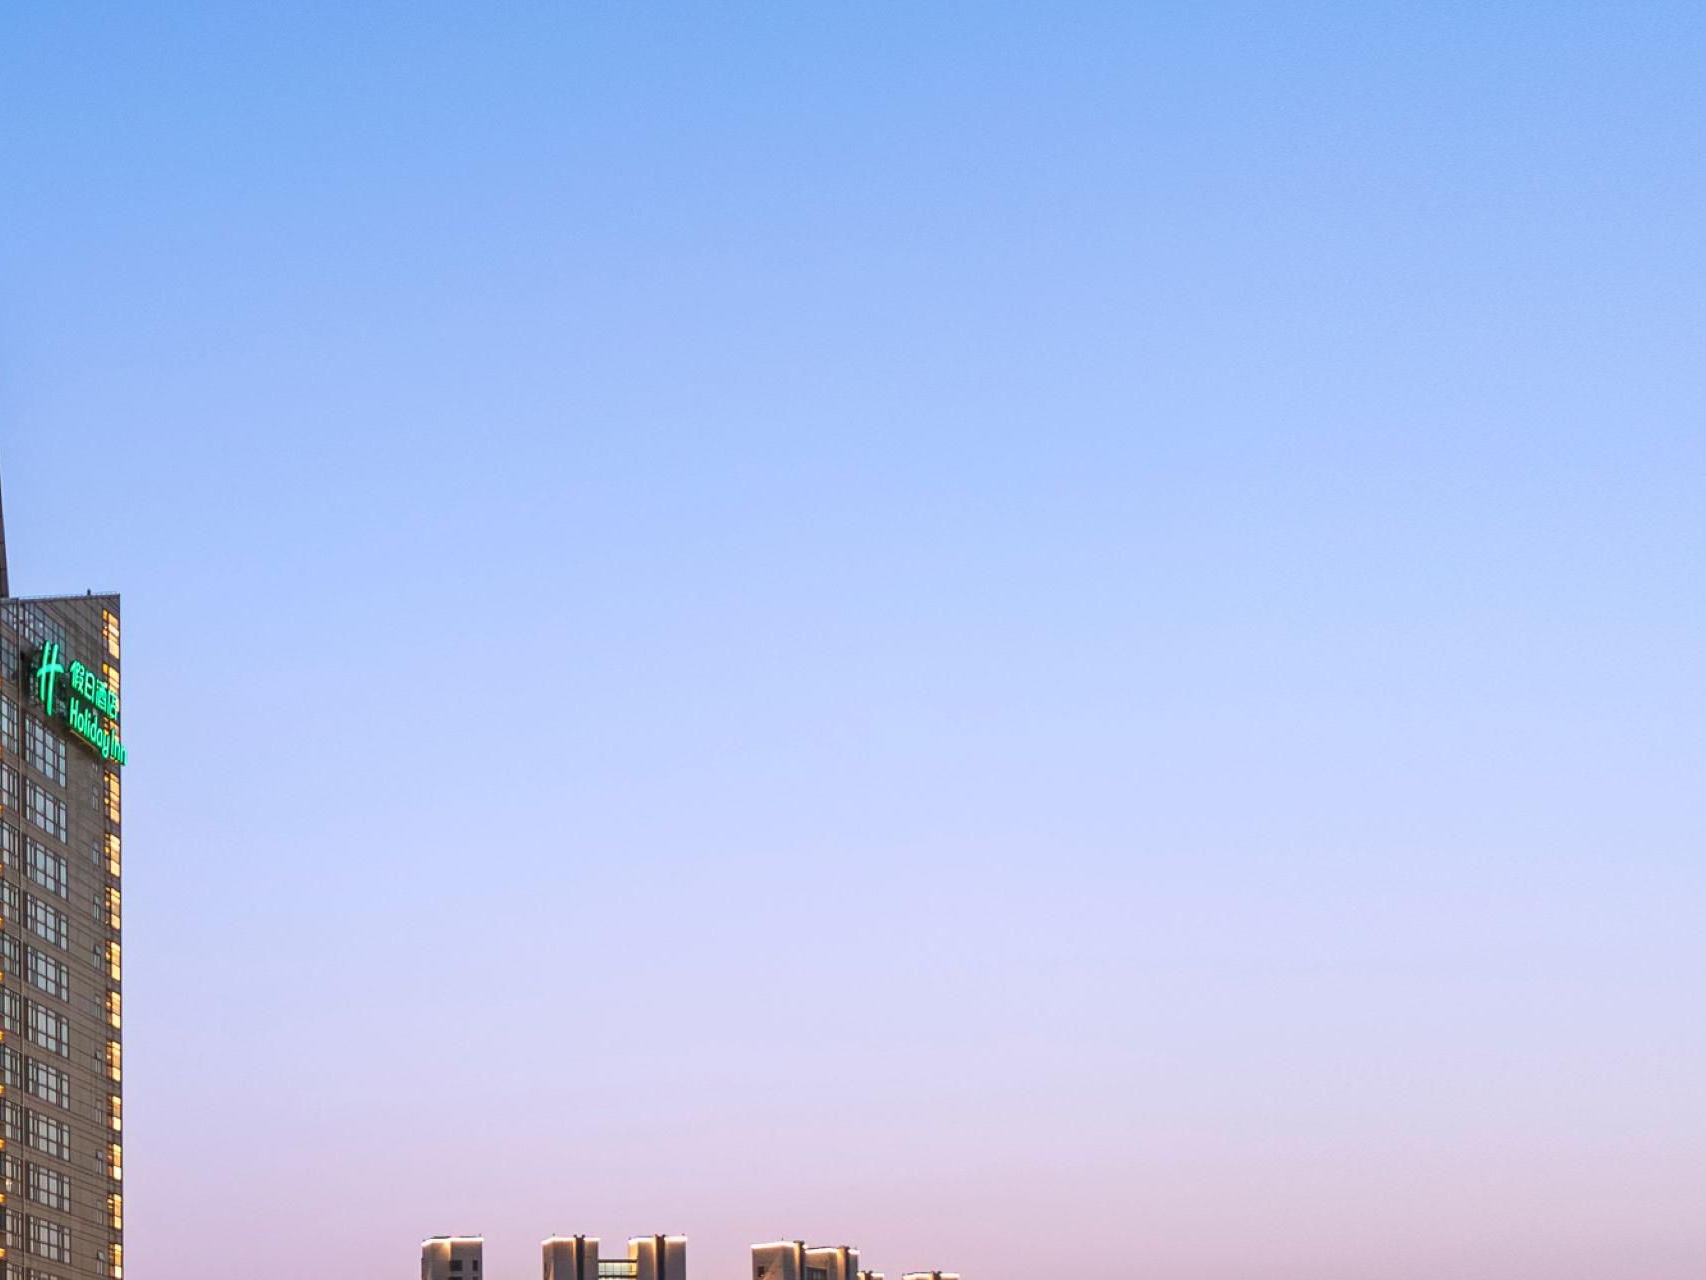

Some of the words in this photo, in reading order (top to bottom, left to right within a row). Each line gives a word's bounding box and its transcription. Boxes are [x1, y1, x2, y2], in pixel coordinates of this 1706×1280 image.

[70, 660, 118, 720] 假日酒店
[69, 697, 109, 759] Holiday
[111, 729, 128, 766] Inn
